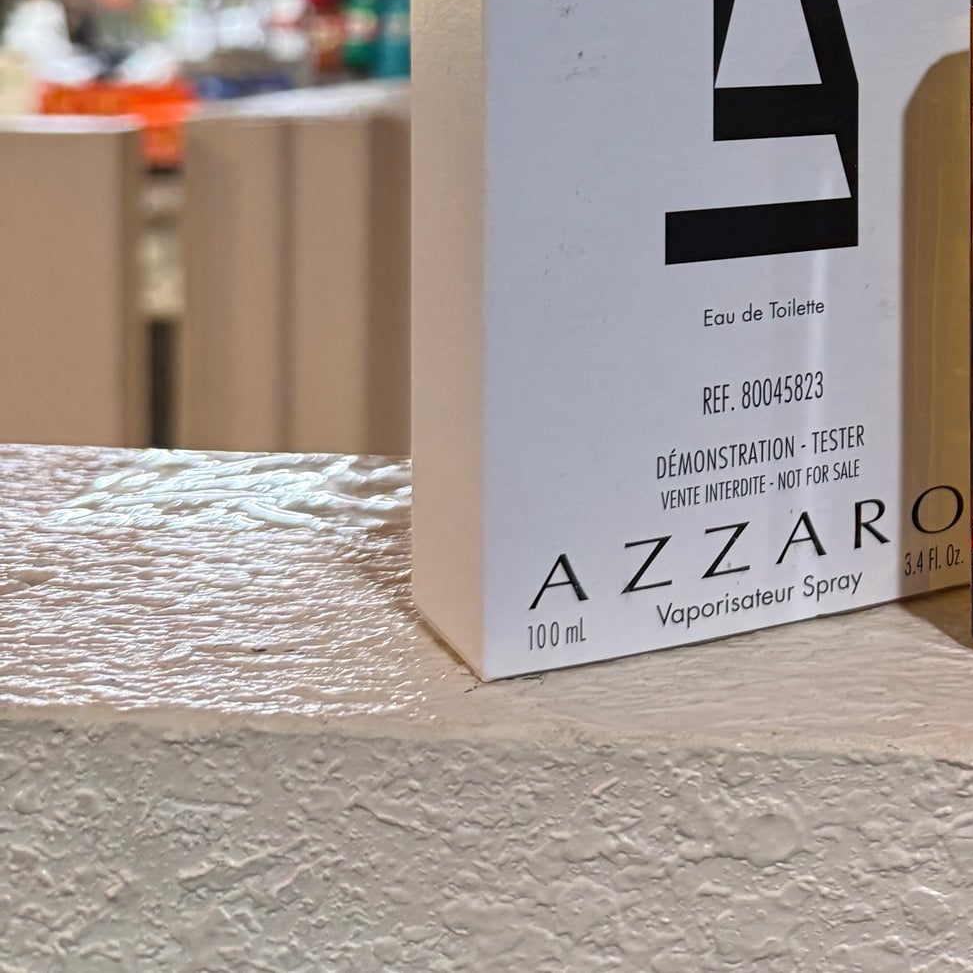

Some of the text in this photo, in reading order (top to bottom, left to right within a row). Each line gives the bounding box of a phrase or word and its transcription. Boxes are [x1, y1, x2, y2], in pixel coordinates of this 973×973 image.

[704, 299, 825, 327] Eau de Toilette
[703, 371, 825, 415] REF. 80045823
[656, 435, 795, 479] DÉMONSTRATION
[812, 425, 865, 454] TESTER
[661, 486, 700, 510] VENTE
[705, 475, 766, 503] INTERDITE
[778, 469, 802, 490] NOT
[806, 464, 829, 486] FOR
[833, 459, 860, 481] SALE
[529, 485, 964, 610] AZZARO
[904, 542, 965, 577] 3.4 Fl. Oz.
[656, 570, 863, 628] Vaporisateur Spray
[527, 618, 586, 651] 100 mL
